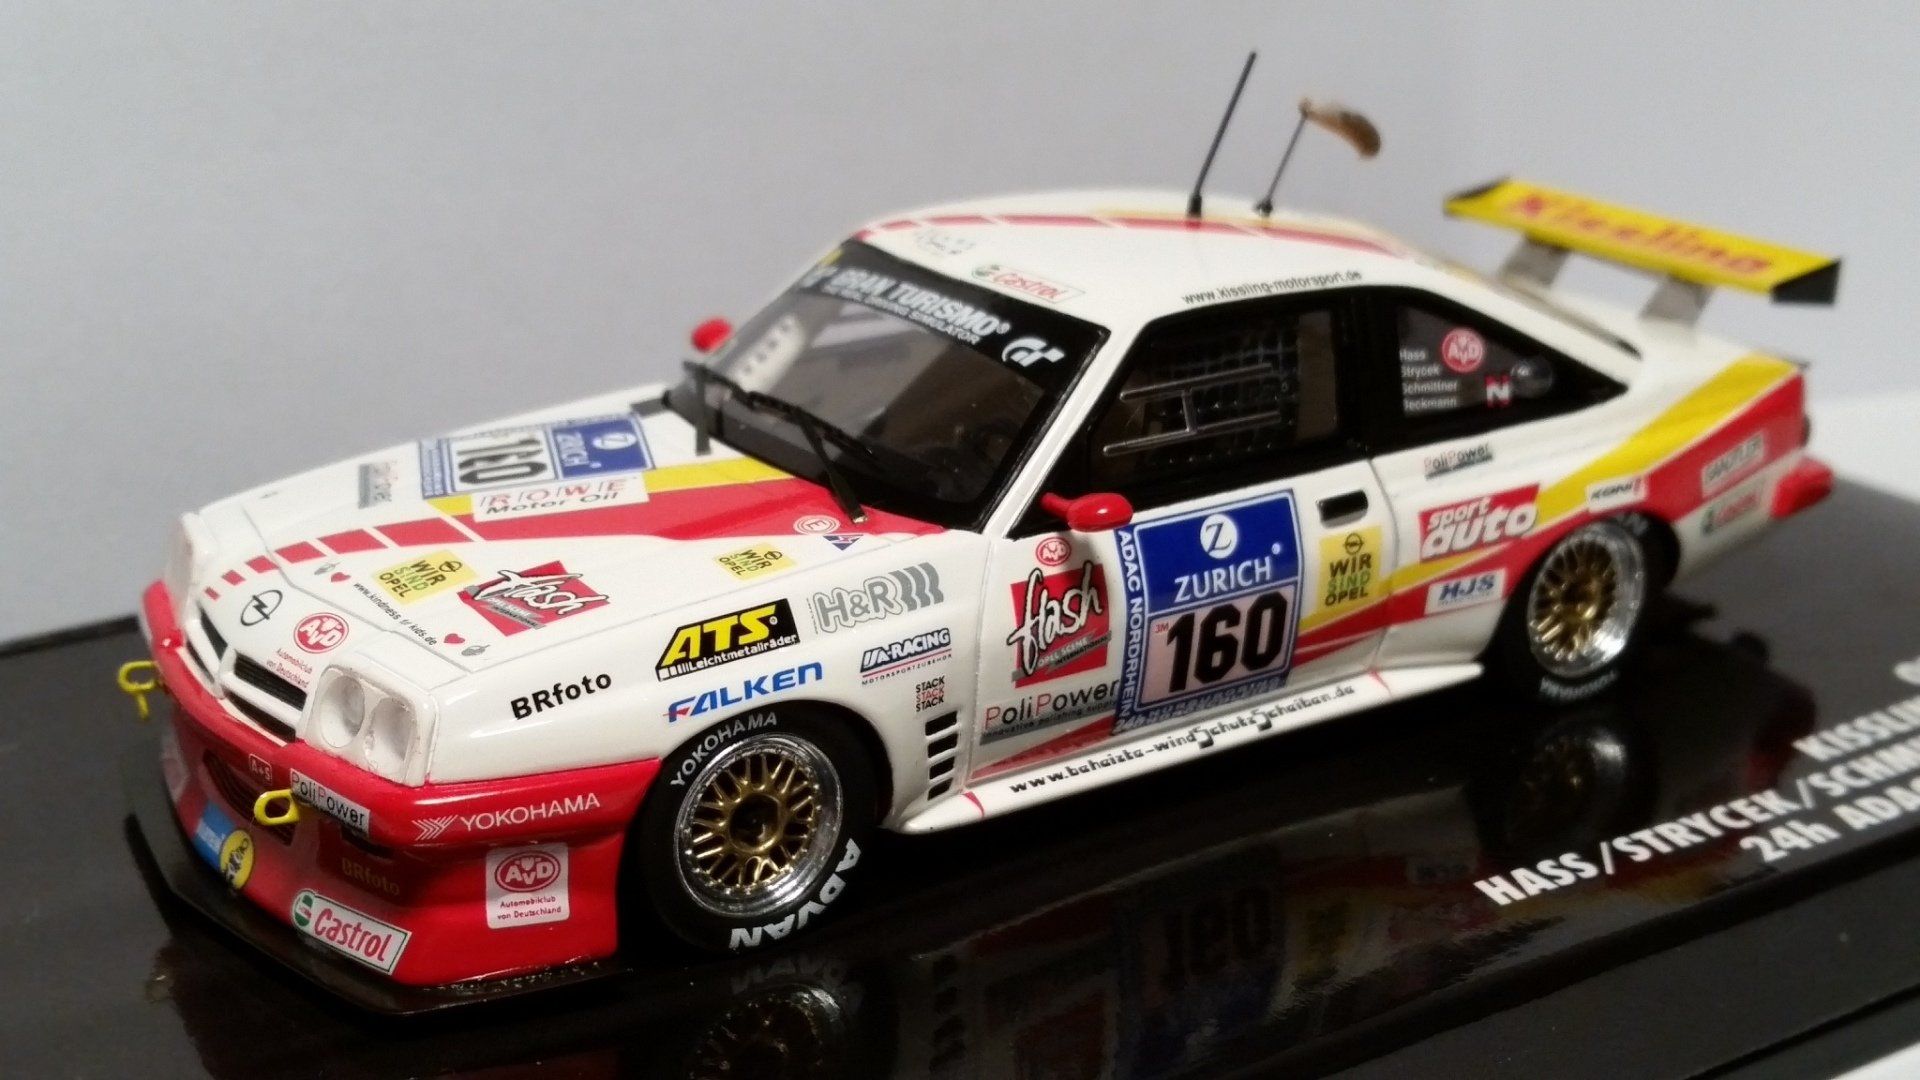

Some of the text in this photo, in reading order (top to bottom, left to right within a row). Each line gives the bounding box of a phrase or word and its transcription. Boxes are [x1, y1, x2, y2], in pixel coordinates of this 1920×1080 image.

[1182, 270, 1362, 305] www.kissling-motorsport.de
[486, 492, 619, 515] Motor Oil
[1427, 496, 1493, 533] sport
[1420, 503, 1539, 560] auto
[410, 559, 447, 586] WIR
[718, 557, 746, 576] OPEL
[730, 553, 759, 572] SIND
[739, 549, 772, 569] WIR
[1329, 552, 1372, 578] WIR
[379, 572, 412, 598] OPEL
[1174, 556, 1271, 603] ZURICH
[1324, 587, 1369, 607] OPEL
[1327, 570, 1371, 594] SIND
[814, 577, 902, 632] H&R
[1005, 560, 1103, 676] flash
[1117, 530, 1144, 718] ADAC NORDRHEIN
[661, 603, 777, 668] ATS
[1166, 591, 1288, 693] 160
[510, 672, 612, 721] BRfoto
[664, 661, 824, 723] FALKEN
[915, 675, 946, 694] STACK
[915, 687, 945, 703] STACK
[915, 694, 945, 712] STACK
[984, 679, 1120, 731] PoliPower
[669, 711, 778, 788] YOKOHAMA
[460, 792, 601, 832] YOKOHAMA
[1739, 776, 1920, 863] 24h ADA
[729, 837, 862, 950] ADVAN
[314, 908, 393, 962] Castrol
